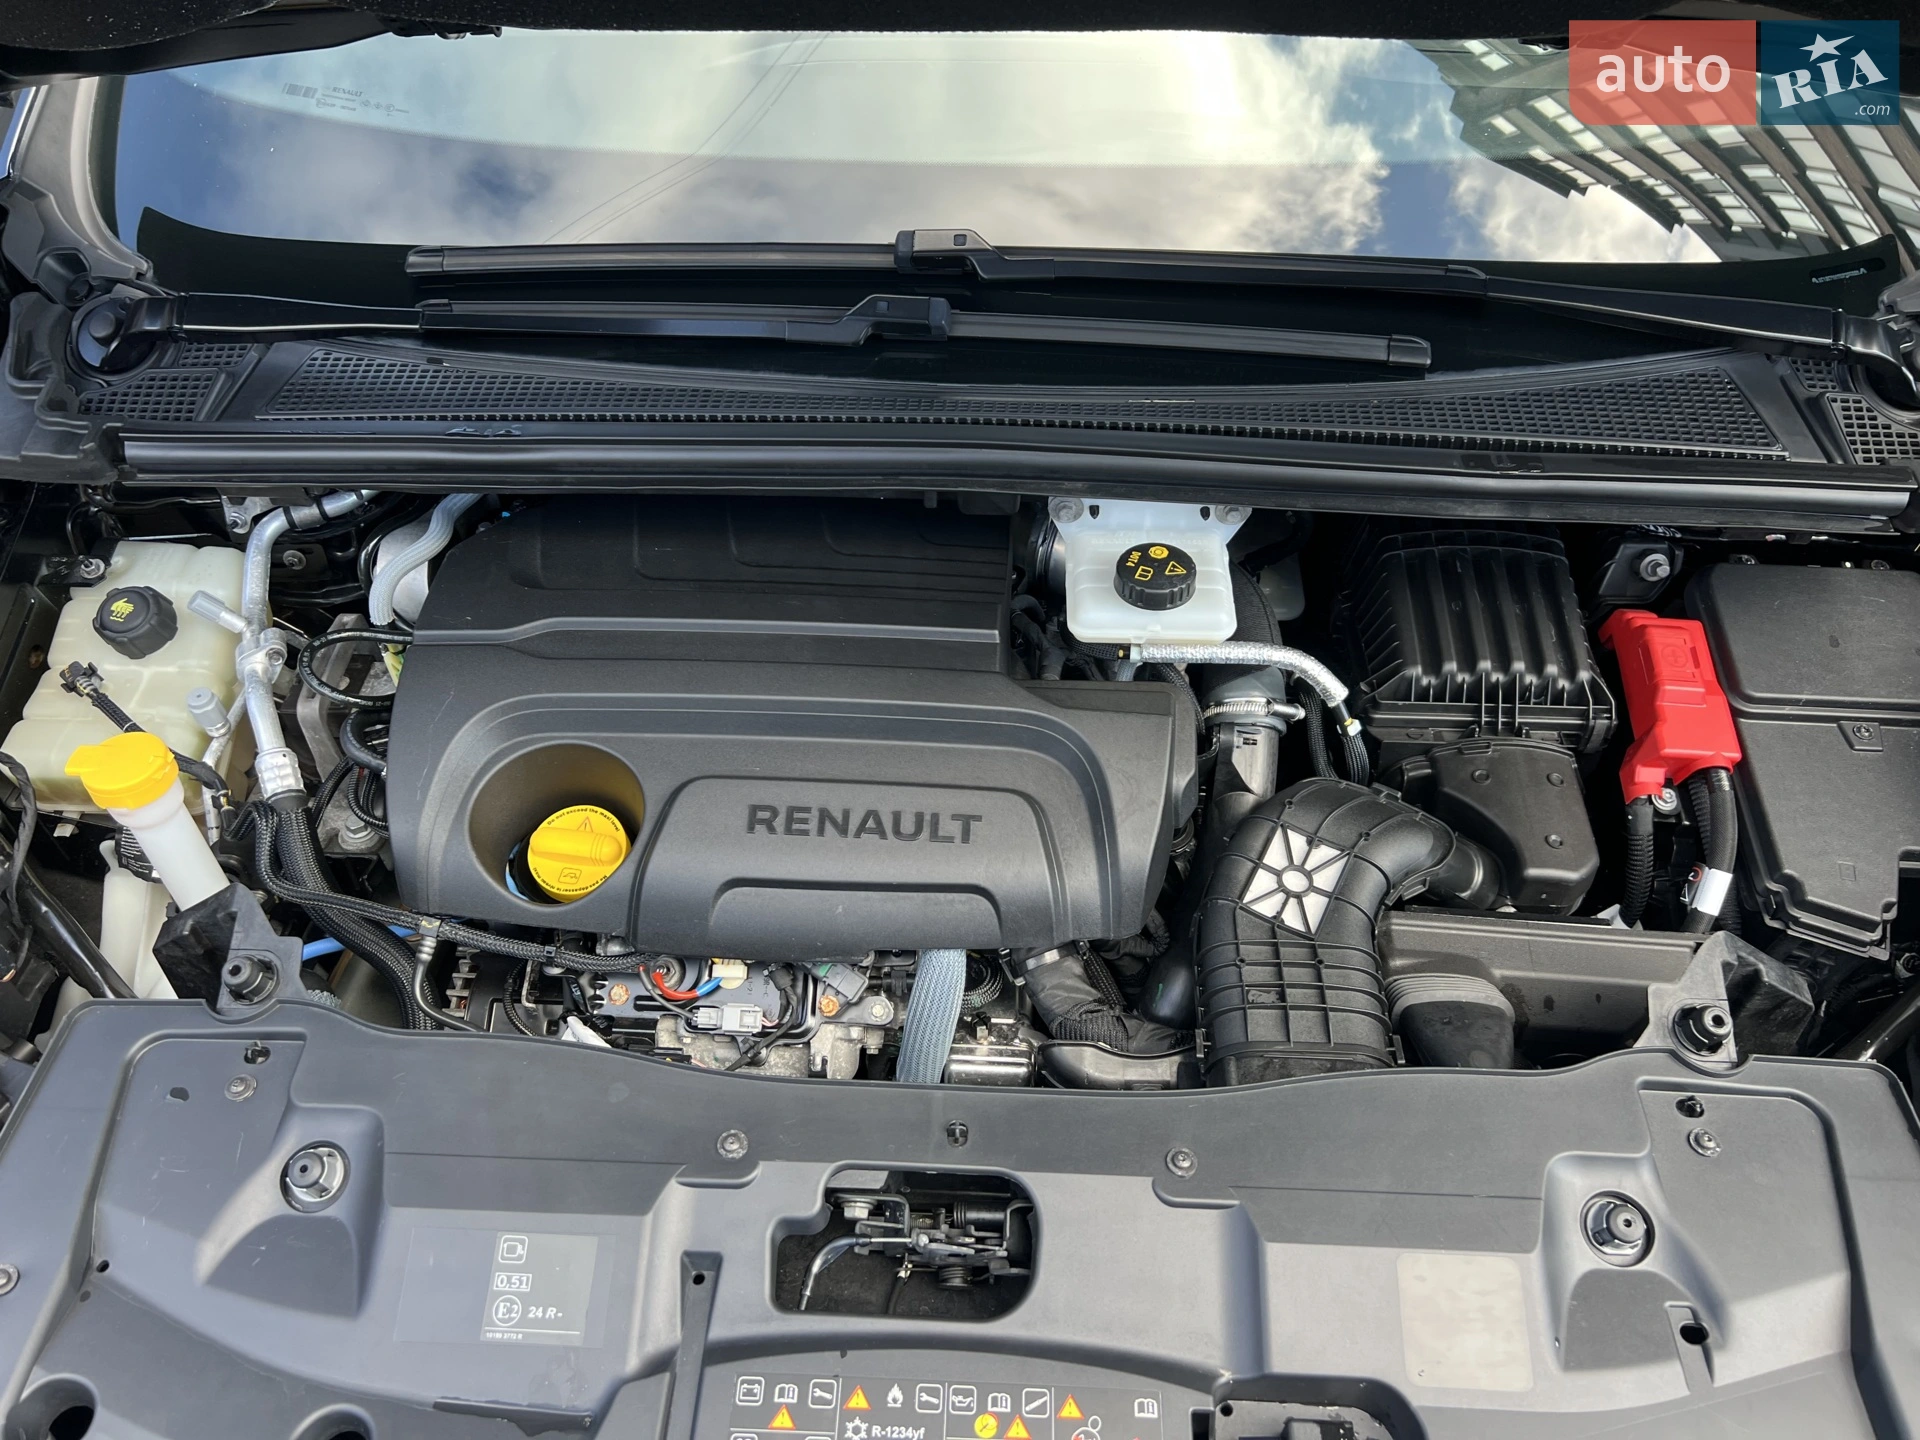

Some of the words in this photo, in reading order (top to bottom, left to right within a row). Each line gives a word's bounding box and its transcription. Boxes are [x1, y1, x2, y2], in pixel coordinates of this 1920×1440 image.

[556, 812, 566, 821] not
[566, 807, 588, 815] exceed
[746, 803, 983, 845] RENAULT
[497, 1275, 528, 1289] 0,51
[528, 1306, 544, 1318] 24
[871, 1425, 925, 1440] R-1234yf
